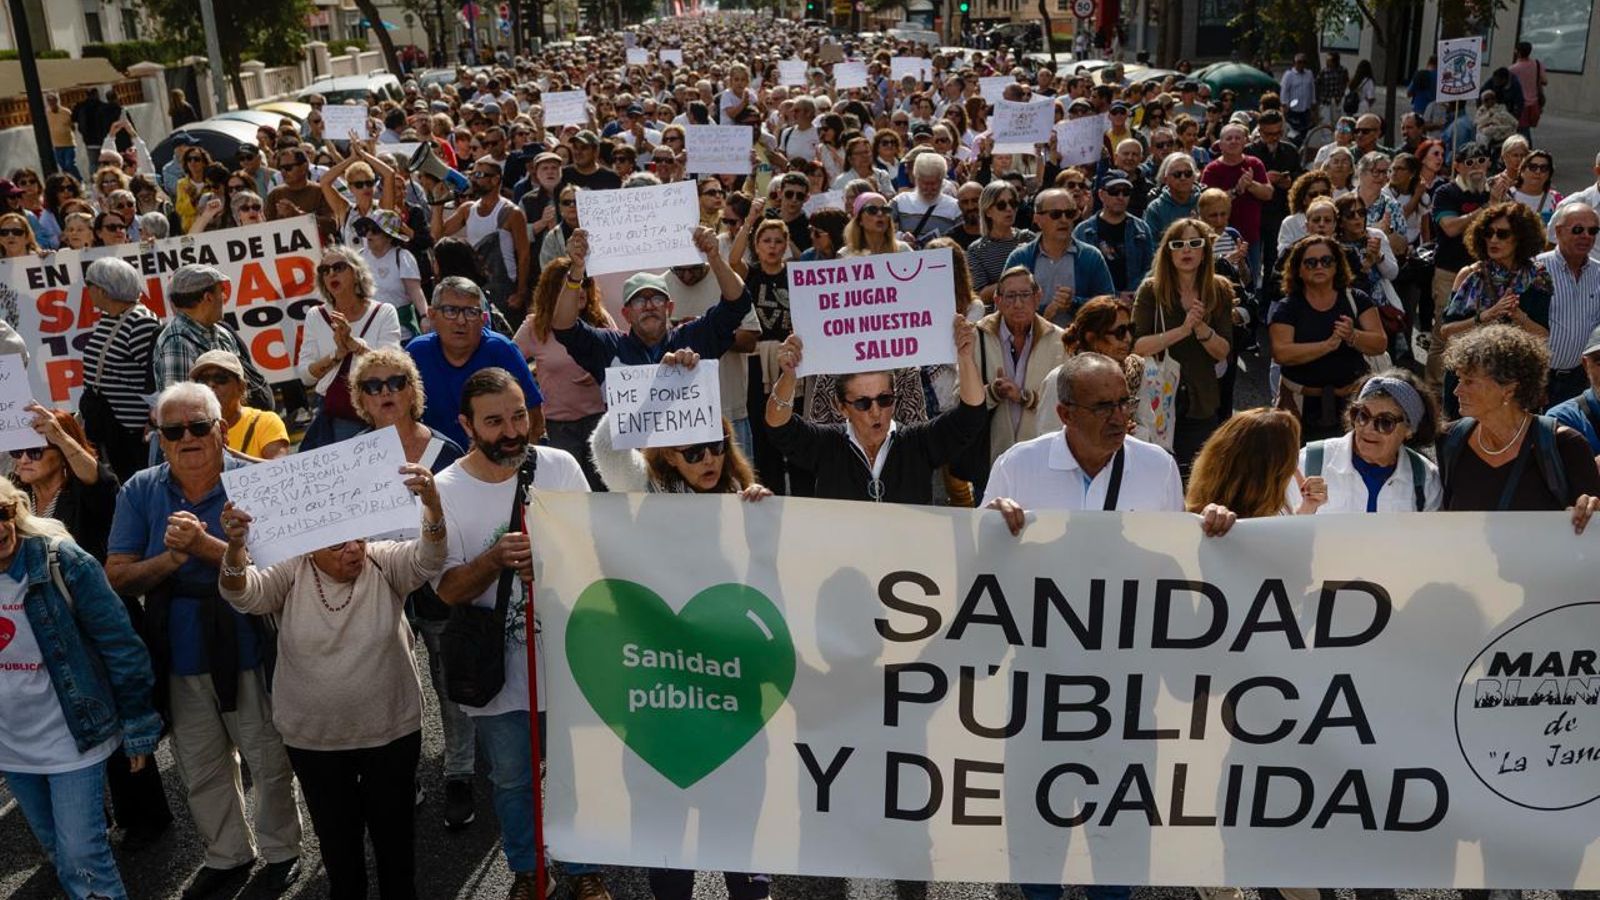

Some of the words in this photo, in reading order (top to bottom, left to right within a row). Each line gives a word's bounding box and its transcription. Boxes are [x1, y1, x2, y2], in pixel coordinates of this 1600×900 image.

[1078, 2, 1090, 12] 50
[26, 264, 70, 290] EN
[226, 236, 265, 262] DE
[273, 228, 312, 255] LA
[793, 266, 848, 286] BASTA
[852, 263, 875, 281] YA
[819, 292, 841, 310] DE
[844, 287, 898, 307] JUGAR
[823, 318, 855, 336] CON
[859, 311, 932, 332] NUESTRA
[855, 337, 919, 361] SALUD
[650, 384, 700, 402] PONES
[617, 405, 714, 434] ENFERMA!
[228, 471, 261, 490] LOS
[354, 437, 378, 455] QUE
[369, 448, 388, 465] EN
[370, 481, 392, 493] DE
[874, 569, 1393, 652] SANIDAD
[622, 643, 741, 679] Sanidad
[629, 682, 739, 713] pública
[1544, 711, 1578, 736] de
[794, 743, 855, 813] Y
[884, 751, 1006, 826] DE
[1035, 761, 1450, 833] CALIDAD
